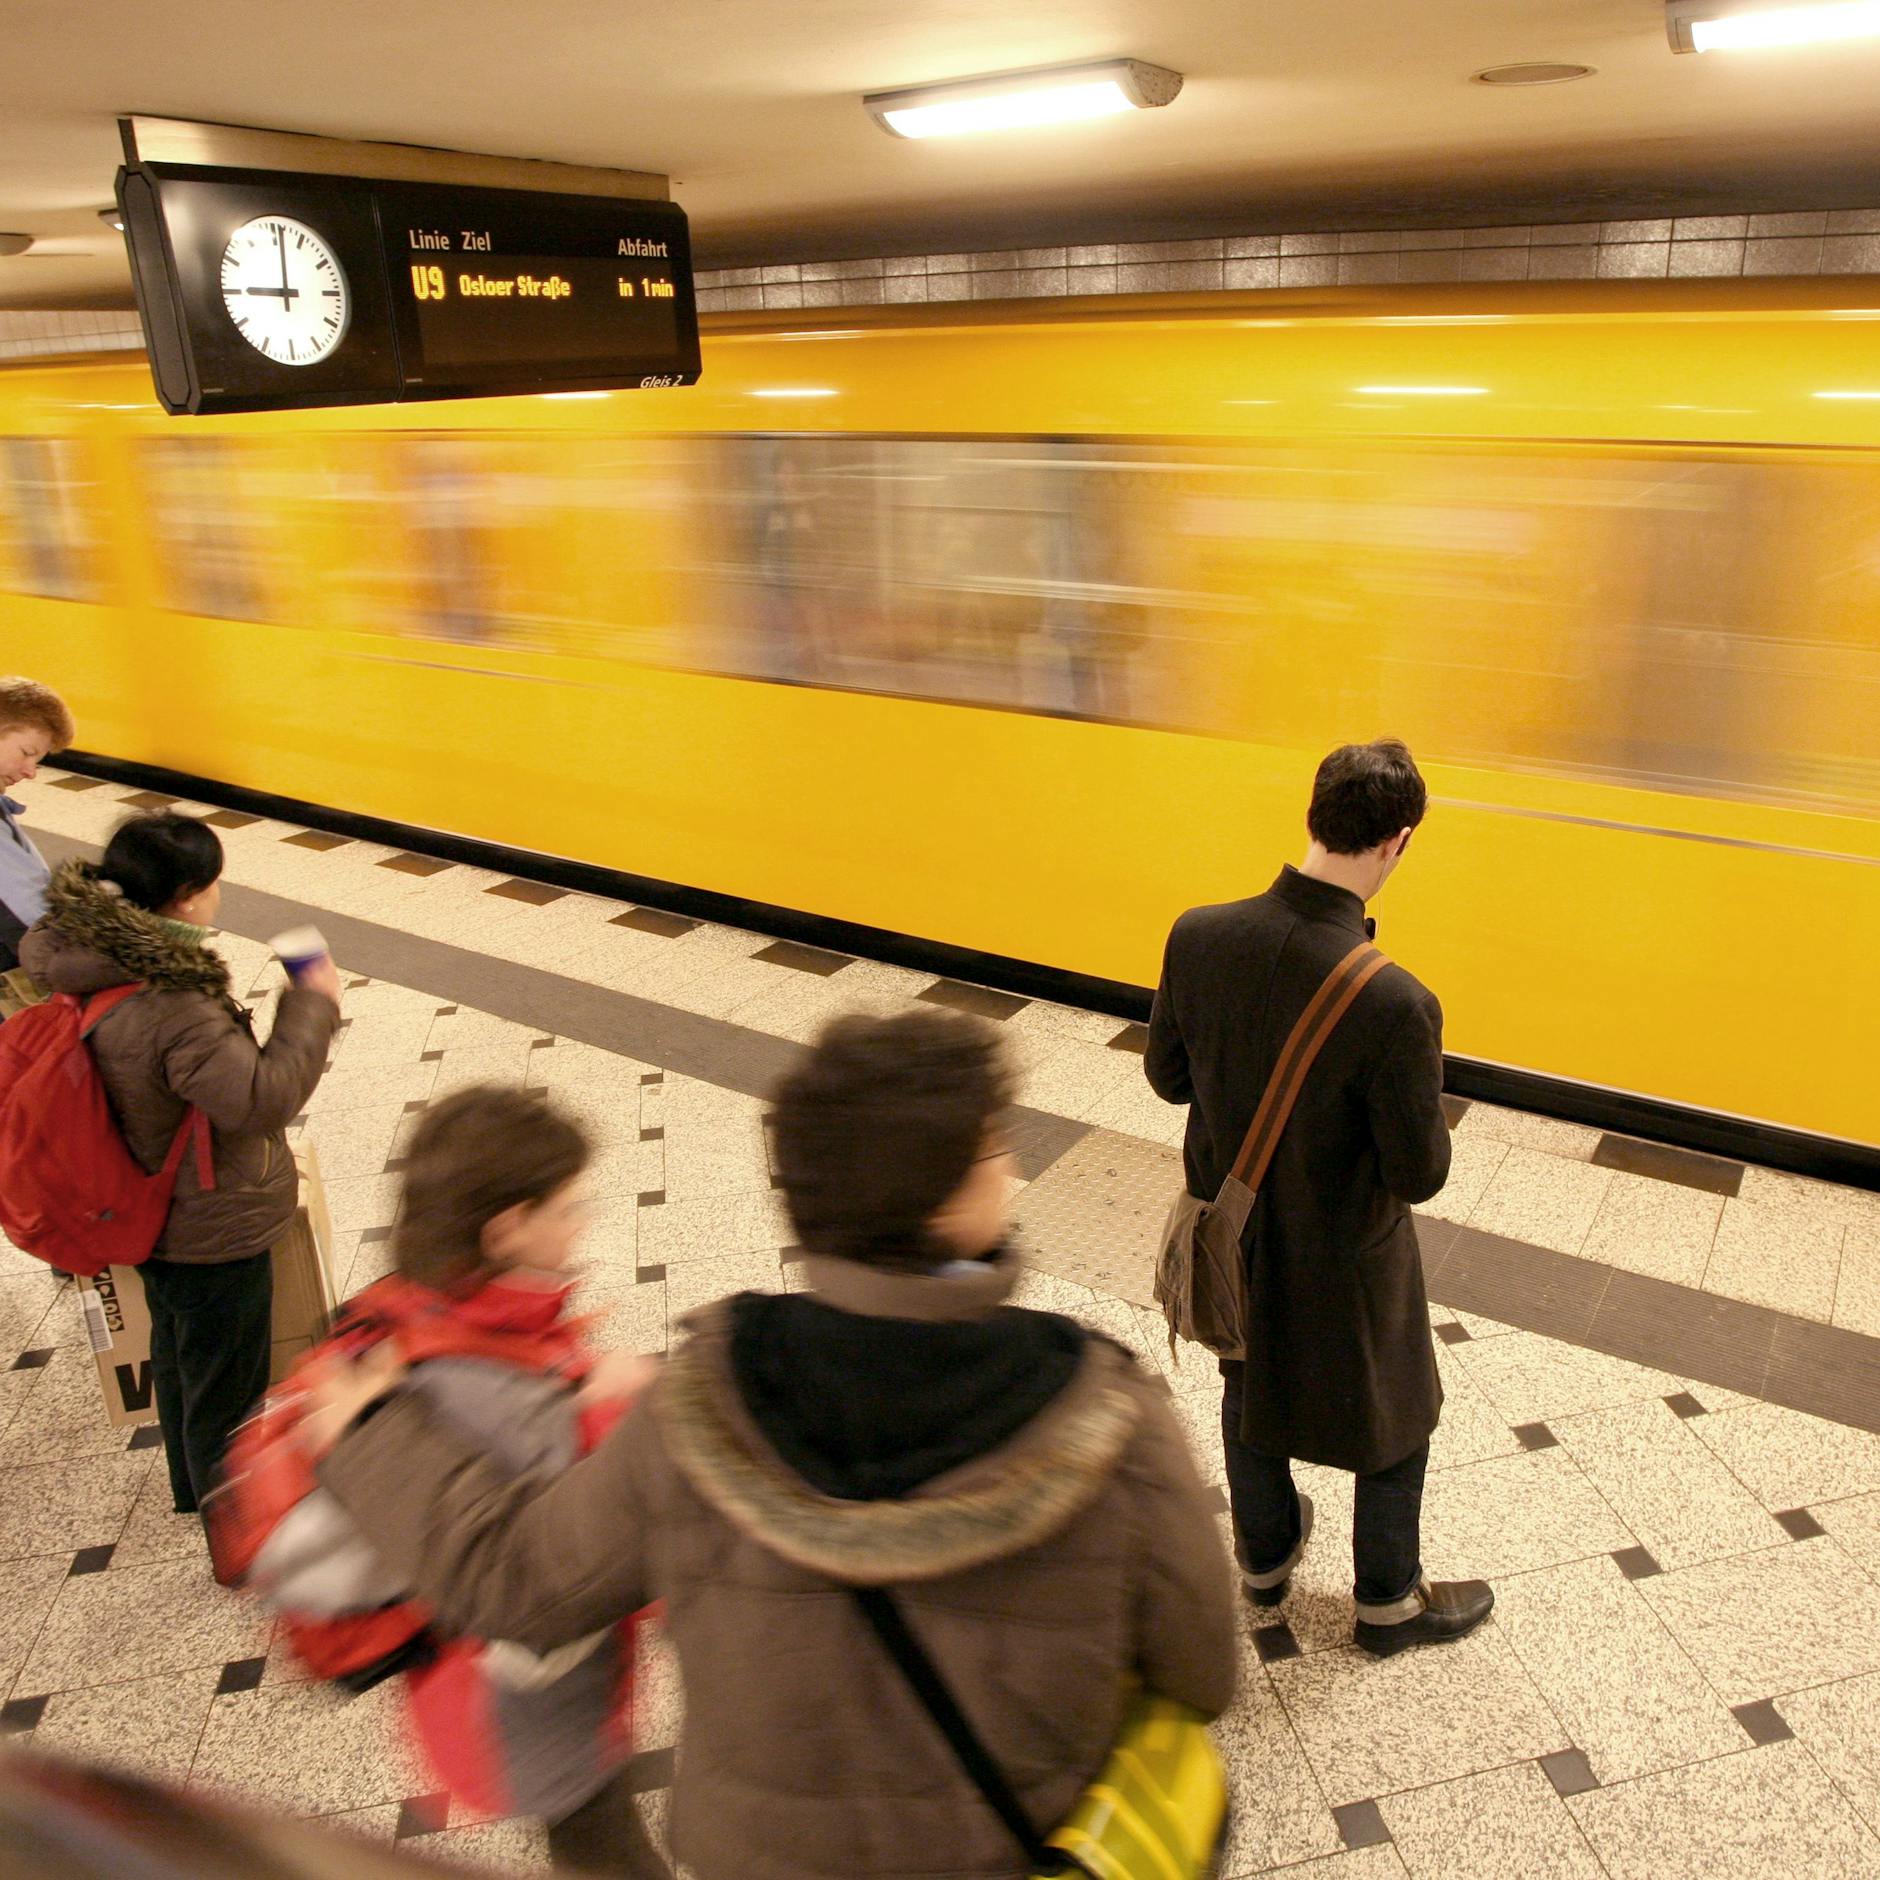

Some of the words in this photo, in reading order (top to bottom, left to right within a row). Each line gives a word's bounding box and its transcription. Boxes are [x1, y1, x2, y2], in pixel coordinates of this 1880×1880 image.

[409, 229, 450, 250] Linie
[461, 231, 491, 251] Ziel
[618, 238, 668, 257] Abfahrt
[411, 266, 445, 300] U9
[459, 275, 514, 296] Osloer
[517, 276, 571, 300] Straße
[618, 278, 633, 297] in
[640, 376, 672, 388] Gleis
[673, 375, 683, 387] 2
